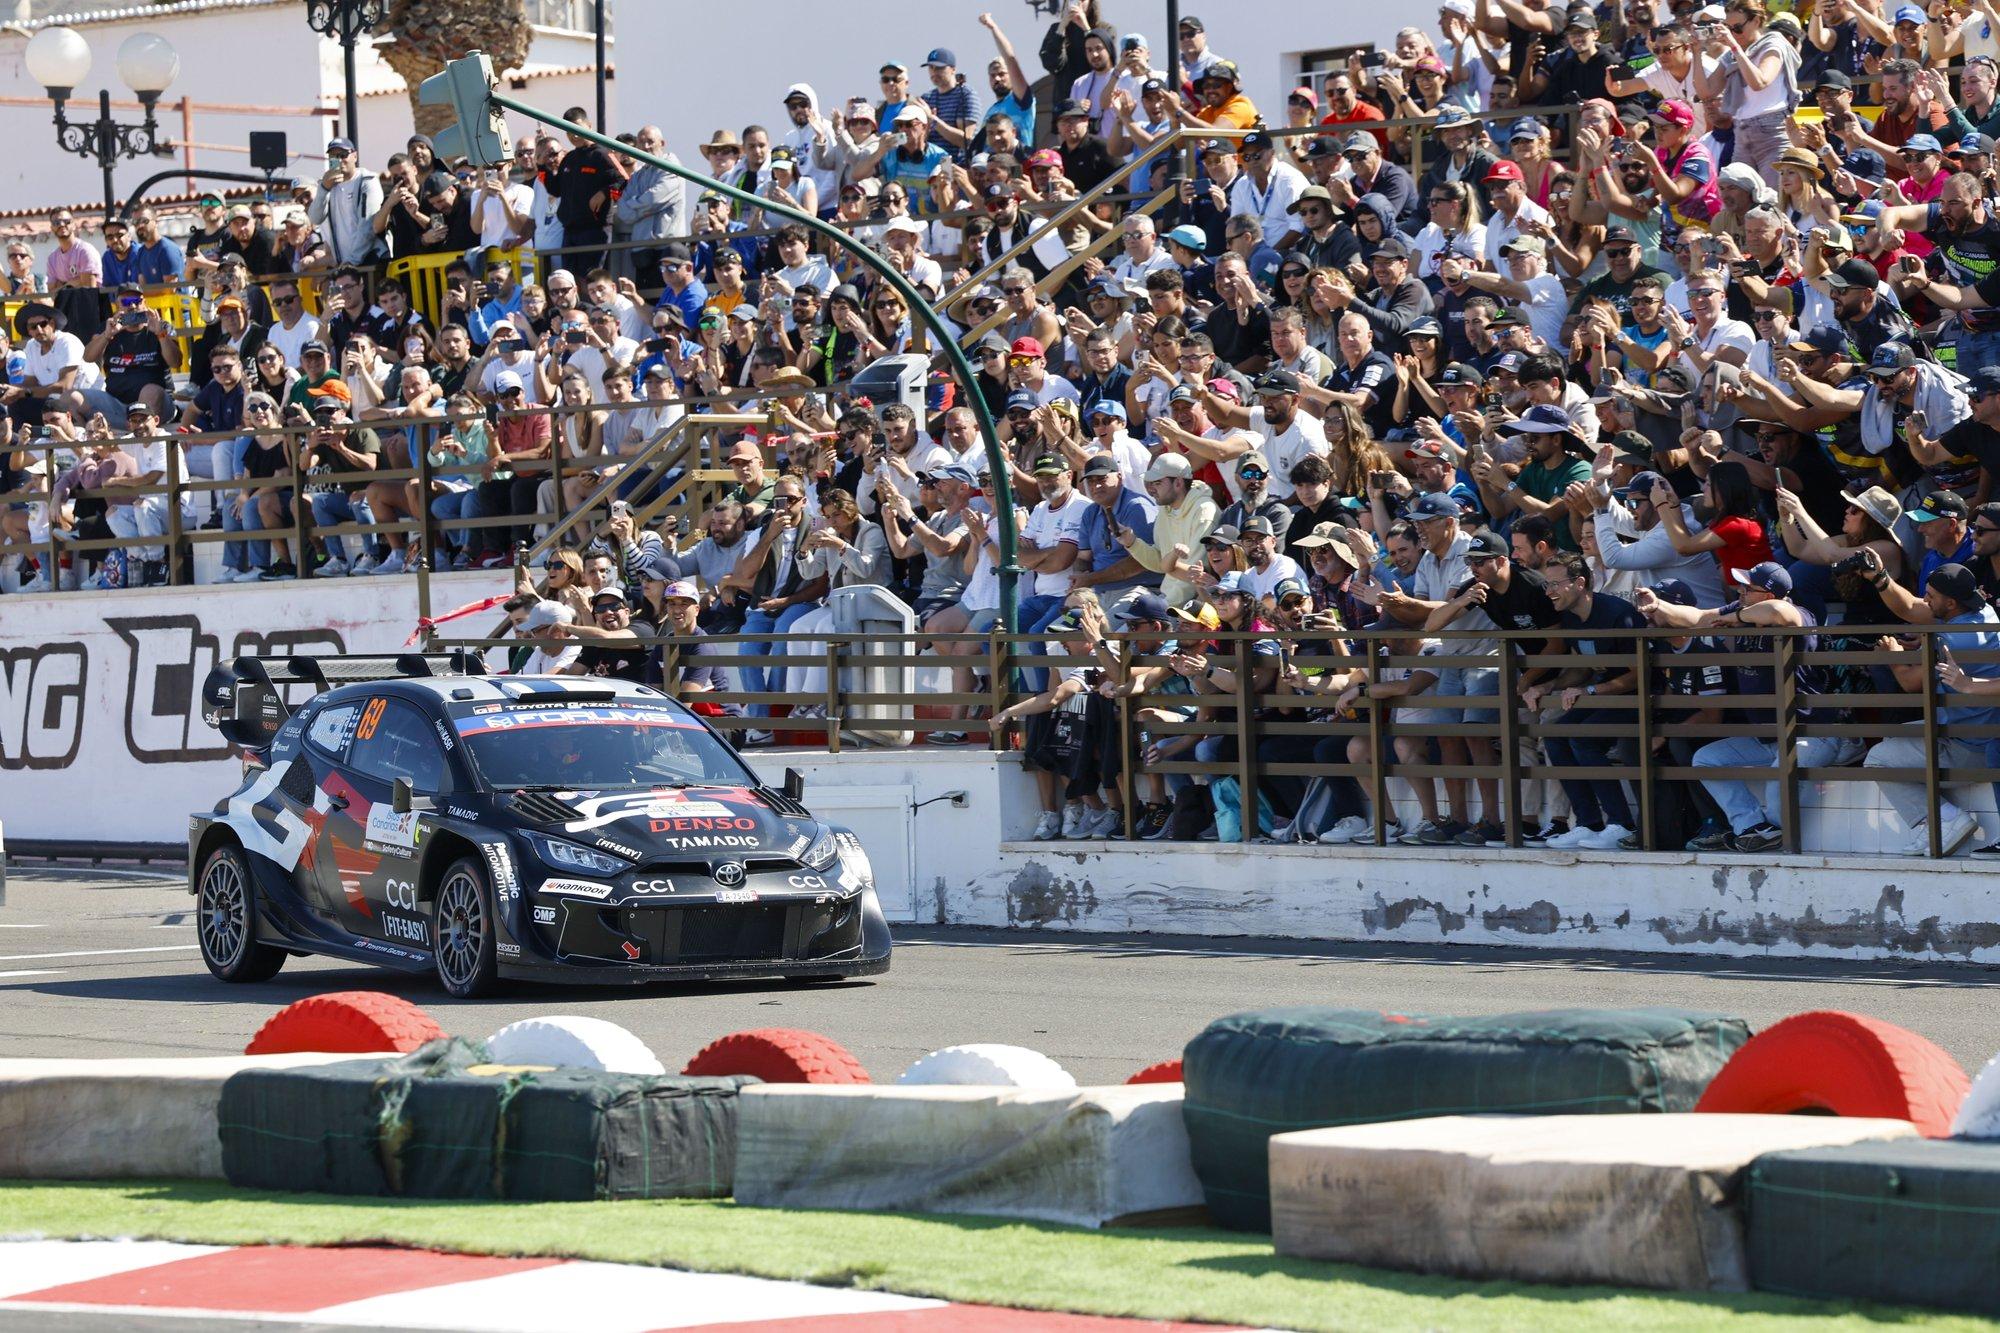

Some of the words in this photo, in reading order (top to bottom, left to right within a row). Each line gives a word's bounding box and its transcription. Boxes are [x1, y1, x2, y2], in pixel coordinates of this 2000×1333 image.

[506, 703, 559, 711] TOYOTA
[567, 702, 618, 711] GAZOO
[621, 703, 667, 712] Racing
[205, 709, 220, 725] Stilo
[356, 697, 387, 740] 69
[262, 721, 278, 731] DENSO
[447, 805, 478, 820] TAMADIC
[372, 817, 399, 833] Canarias
[650, 817, 755, 833] DENSO
[666, 836, 760, 849] TAMADIC
[481, 842, 510, 902] AUTOMOTIVE
[493, 842, 520, 899] Panasonic
[533, 909, 556, 921] OMP
[366, 943, 387, 953] TOYOTA
[386, 947, 408, 957] GAZOO
